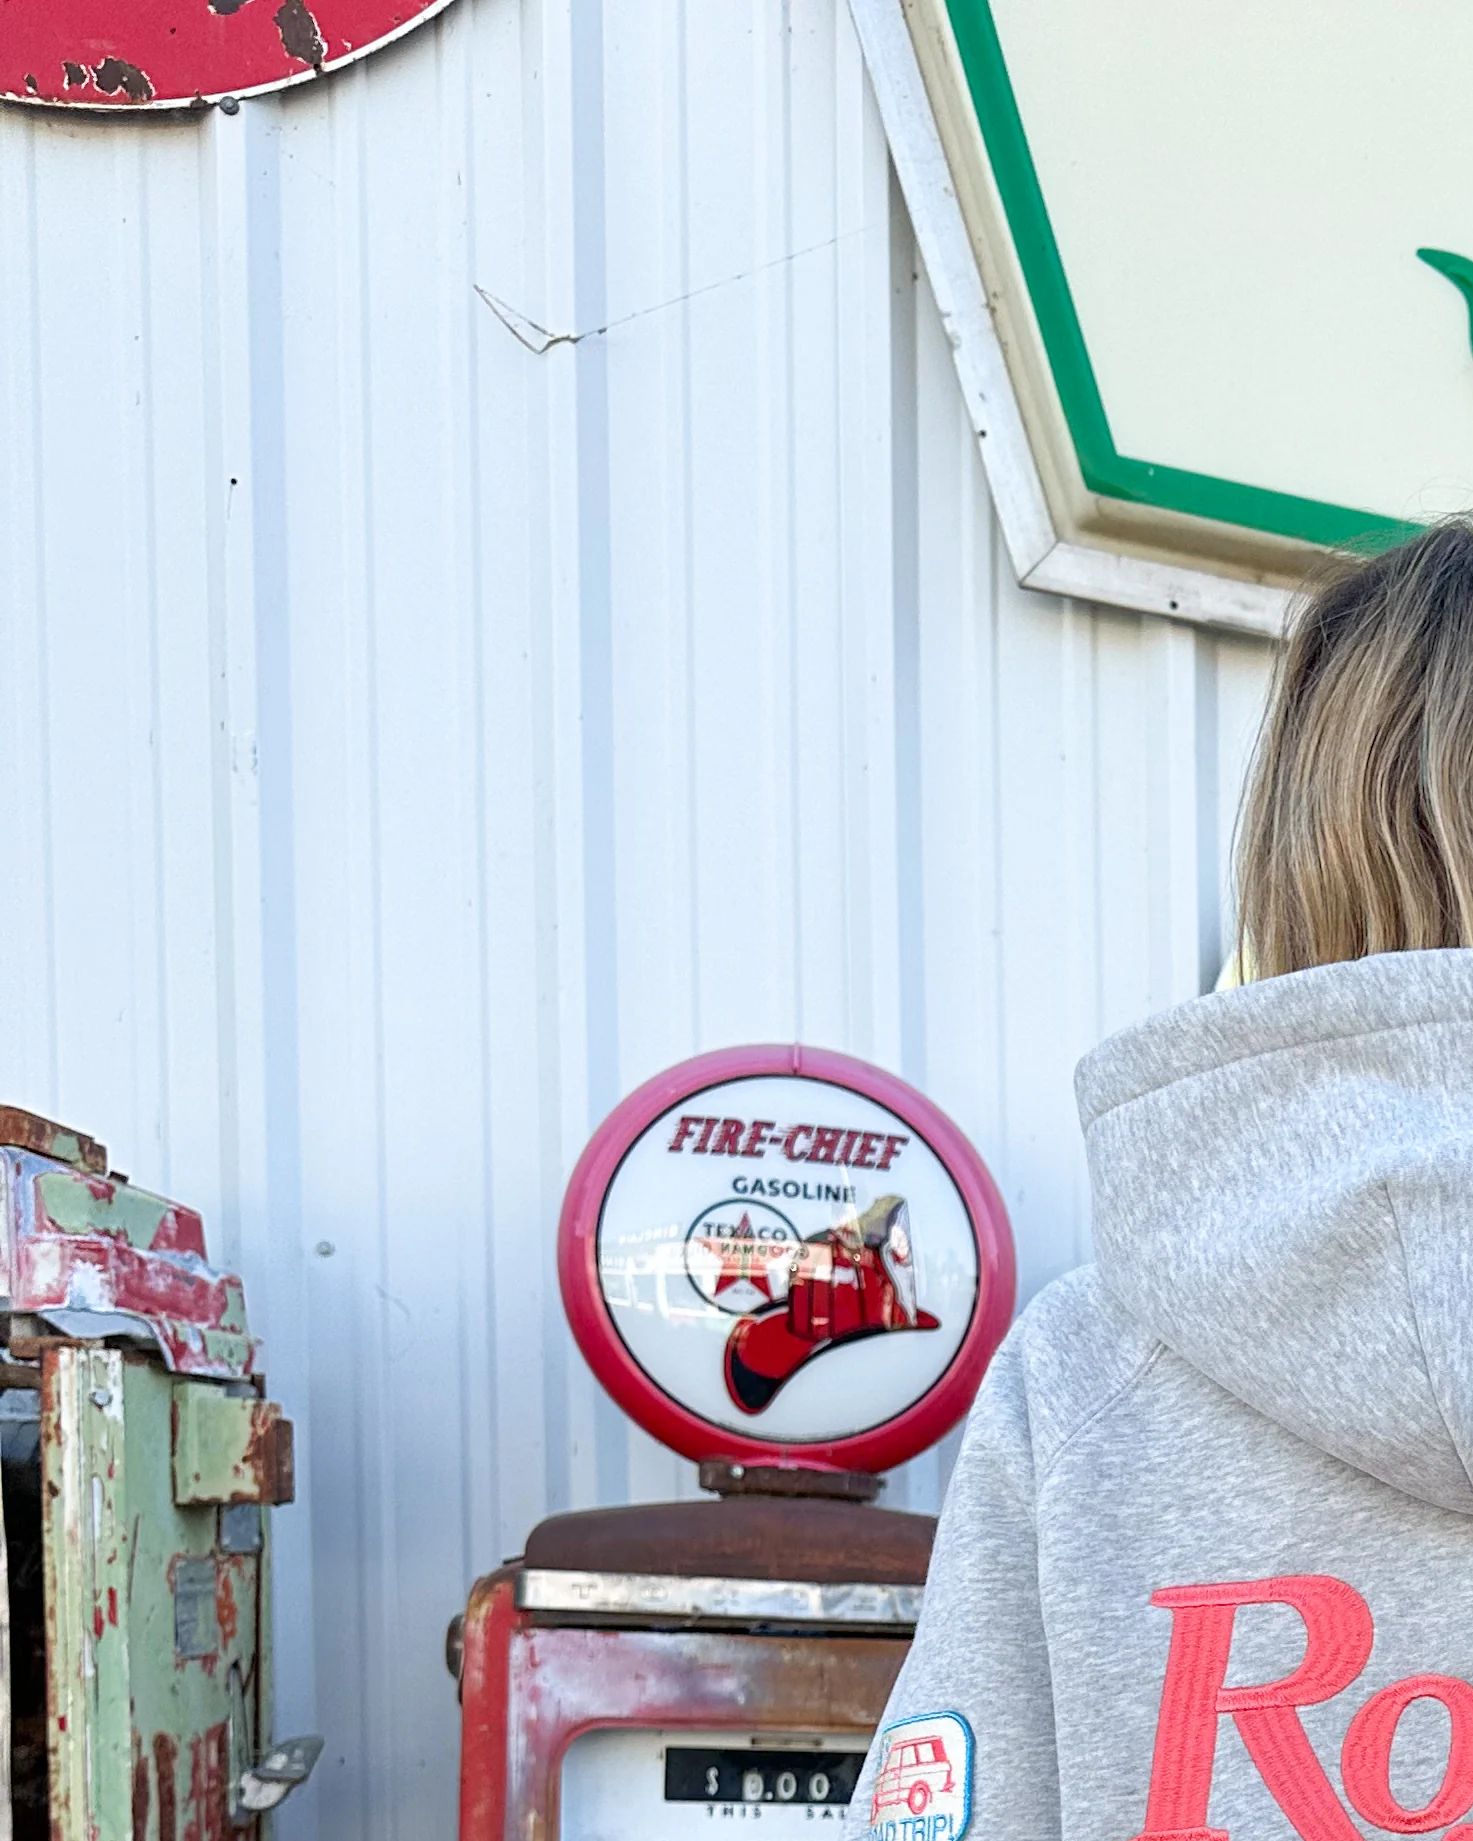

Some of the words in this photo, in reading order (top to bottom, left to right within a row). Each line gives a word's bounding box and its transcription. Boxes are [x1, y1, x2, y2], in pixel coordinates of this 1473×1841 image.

[667, 1115, 910, 1171] FIRE-CHIEF
[732, 1175, 856, 1203] GASOLINE
[703, 1221, 788, 1241] TEXACO
[706, 1806, 762, 1819] THIS
